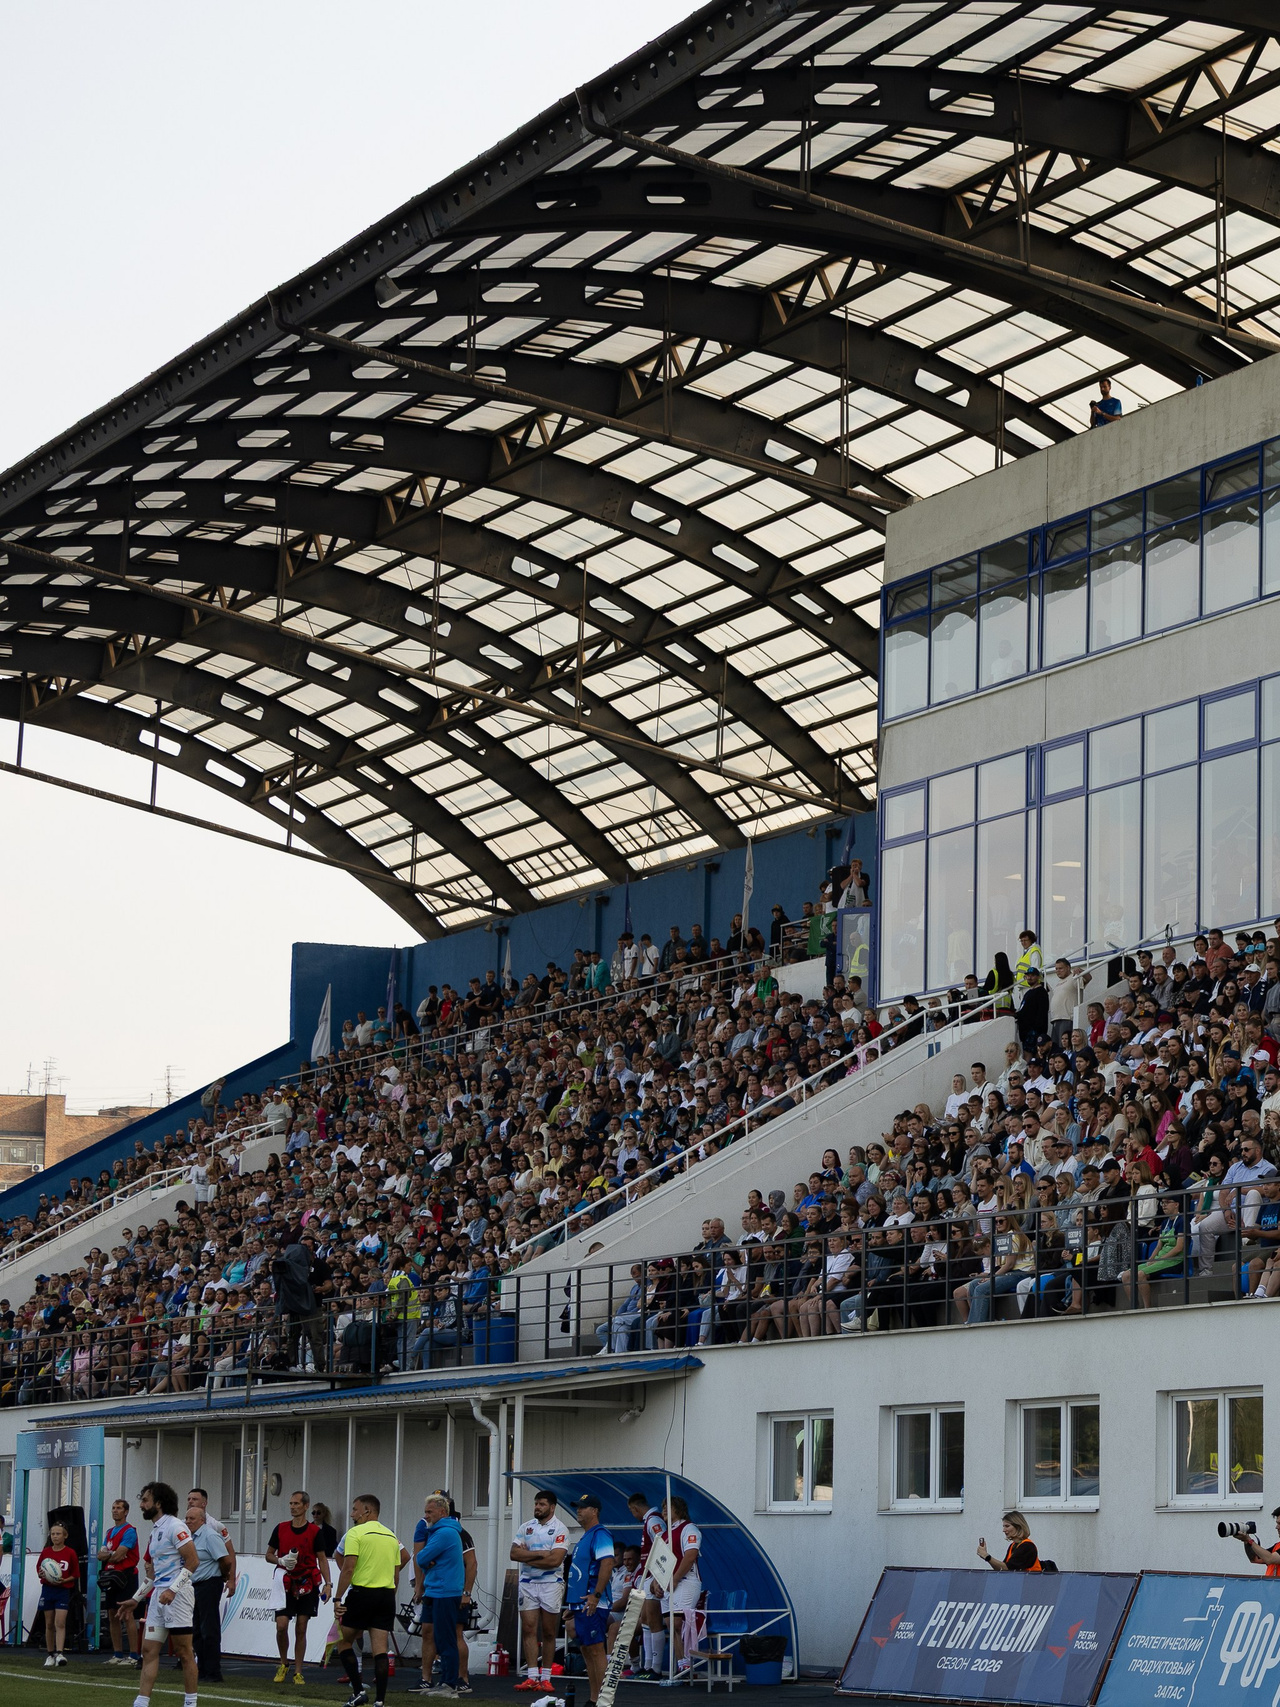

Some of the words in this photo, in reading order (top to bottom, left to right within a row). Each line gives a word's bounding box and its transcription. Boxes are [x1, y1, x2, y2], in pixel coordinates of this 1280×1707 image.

[898, 1622, 915, 1630] РЕГБИ
[917, 1601, 986, 1650] РЕГБИ
[979, 1603, 1055, 1653] РОССИИ
[894, 1631, 915, 1639] РОССИИ
[1077, 1630, 1097, 1640] РЕГБИ
[1074, 1640, 1099, 1650] РОССИИ
[1127, 1635, 1204, 1652] СТРАТЕГИЧЕСКИЙ
[607, 1644, 629, 1689] ЕНИСЕЙ-СТМ
[936, 1656, 971, 1670] СЕЗОН
[970, 1659, 1003, 1673] 2026
[1127, 1659, 1195, 1676] ПРОДУКТОВЫЙ
[1154, 1685, 1185, 1700] ЗАПАС
